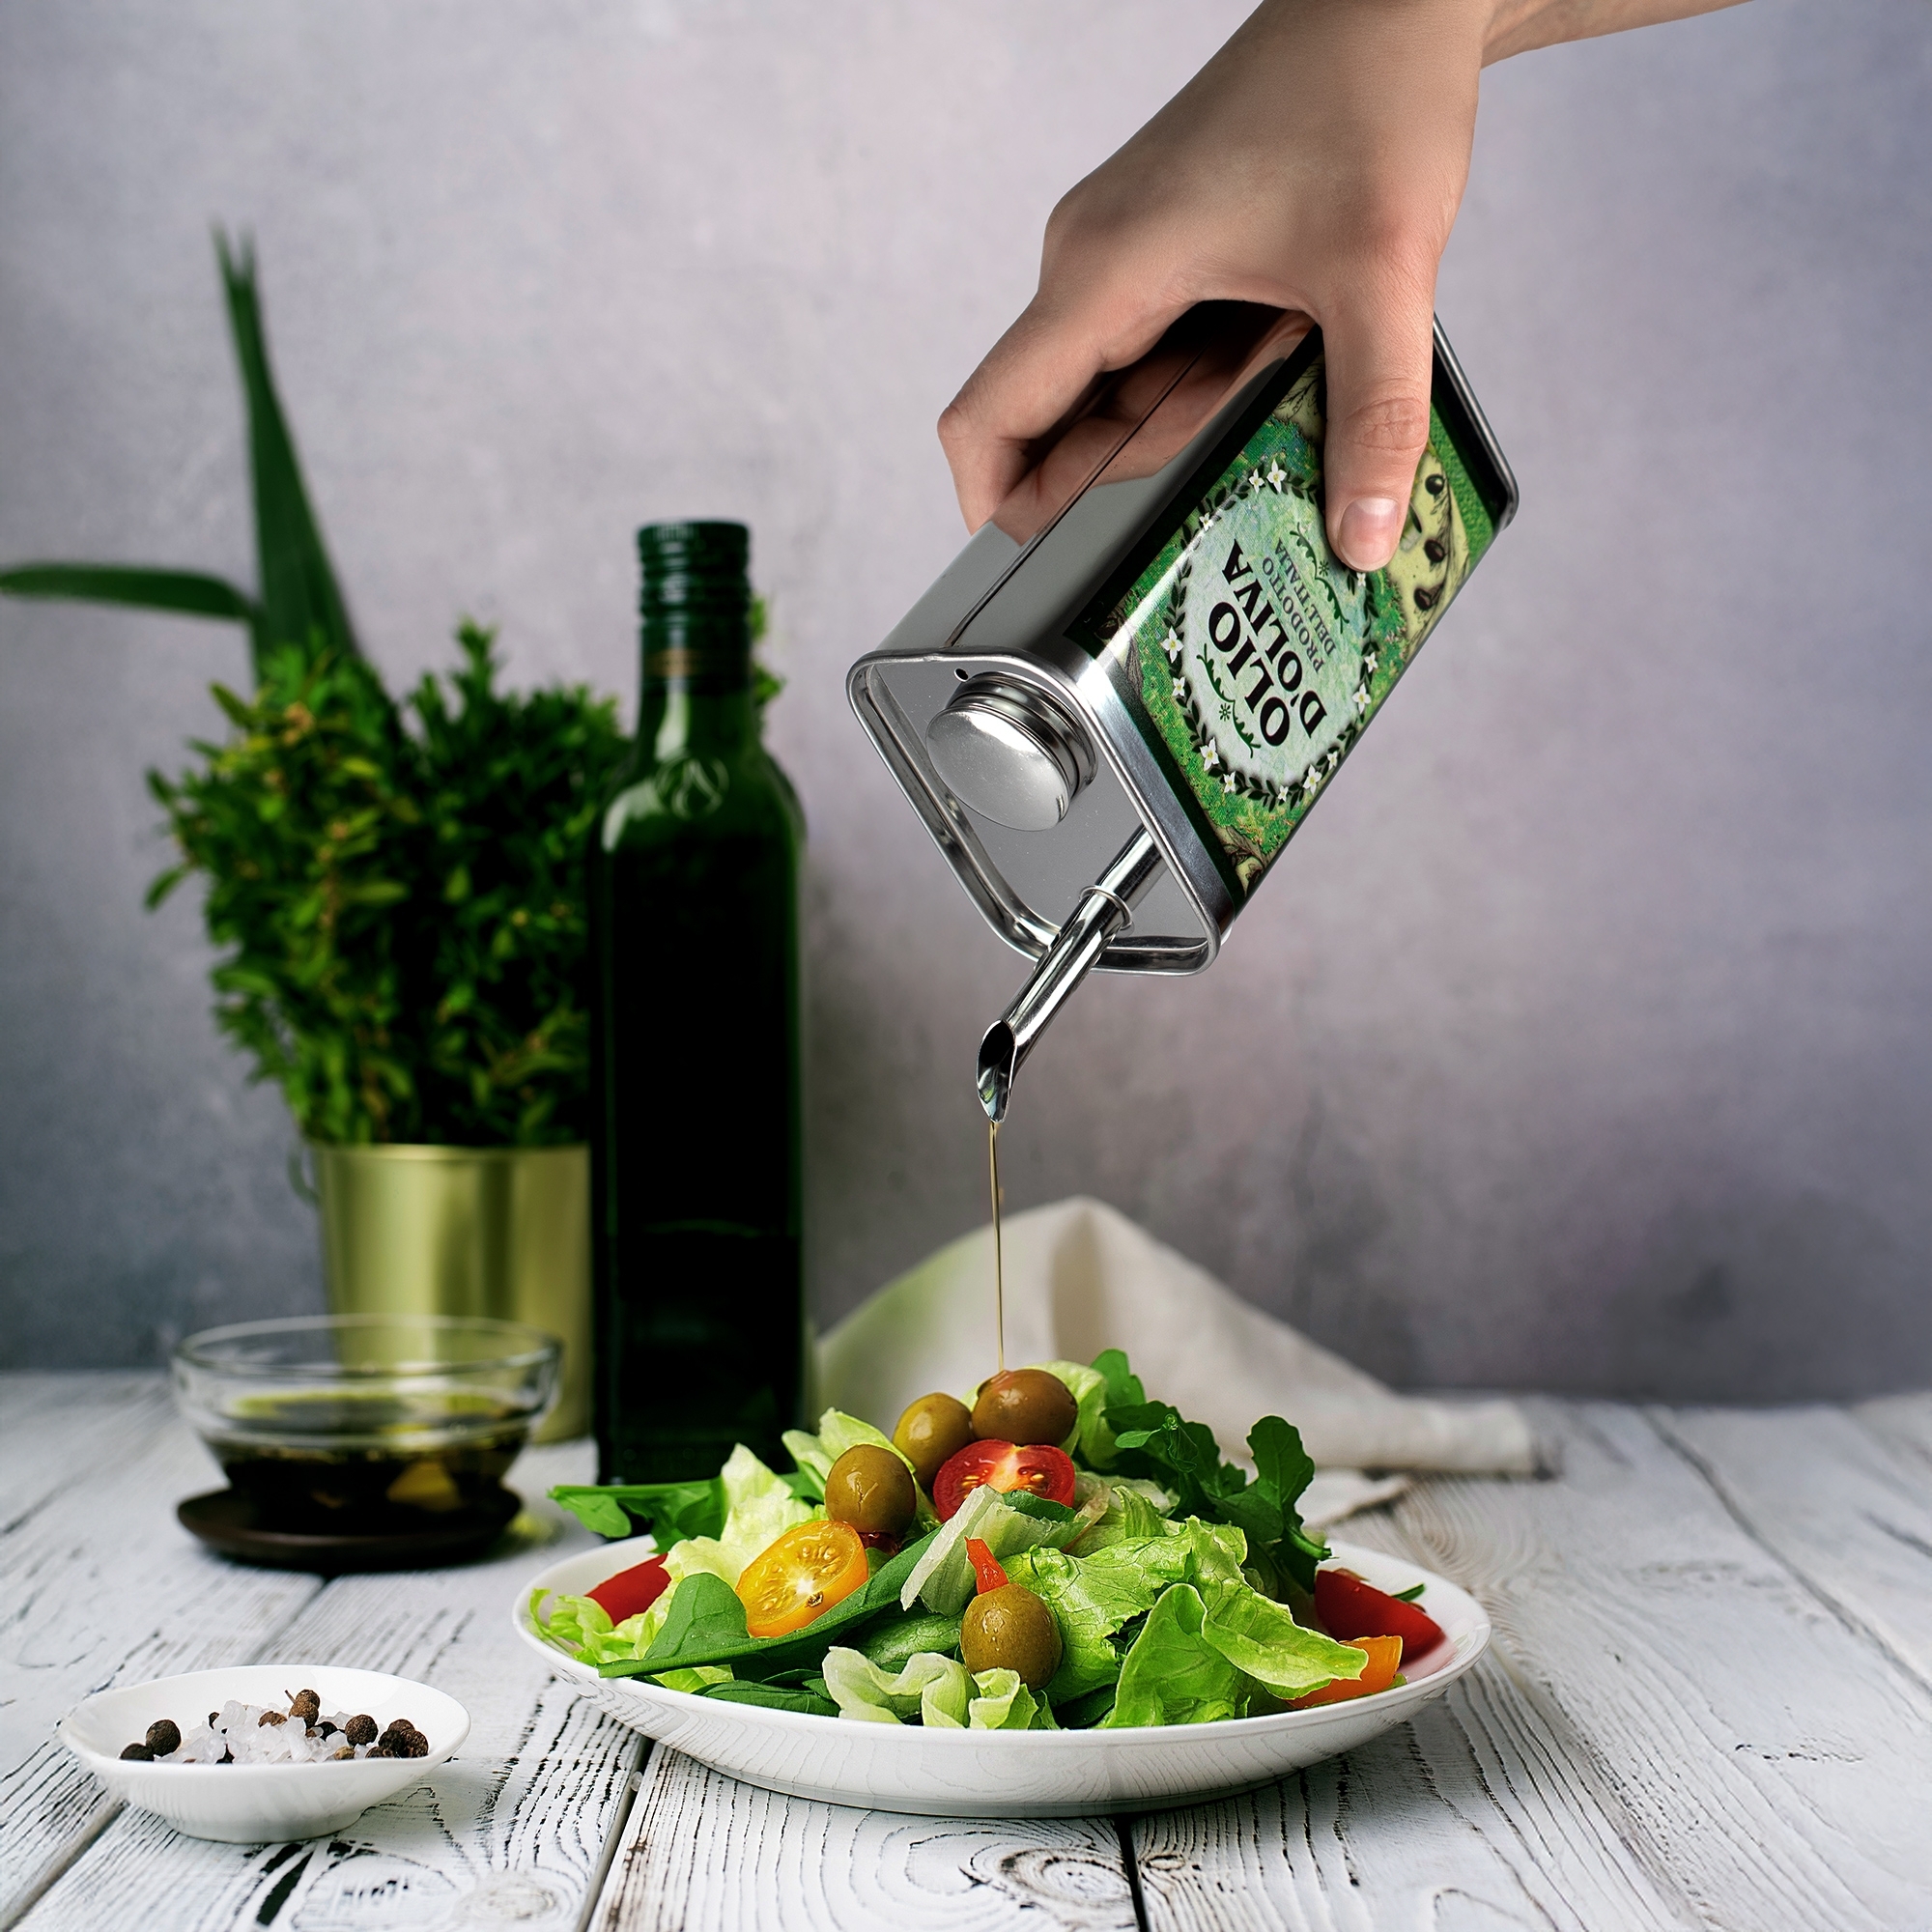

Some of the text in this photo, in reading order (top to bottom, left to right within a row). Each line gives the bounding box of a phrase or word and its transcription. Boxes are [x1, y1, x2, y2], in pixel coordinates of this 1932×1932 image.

[1222, 539, 1327, 738] D'OLIVA
[1262, 556, 1325, 673] PRODOTTO
[1274, 538, 1336, 655] DELL'ITALIA
[1208, 602, 1290, 747] OLIO
